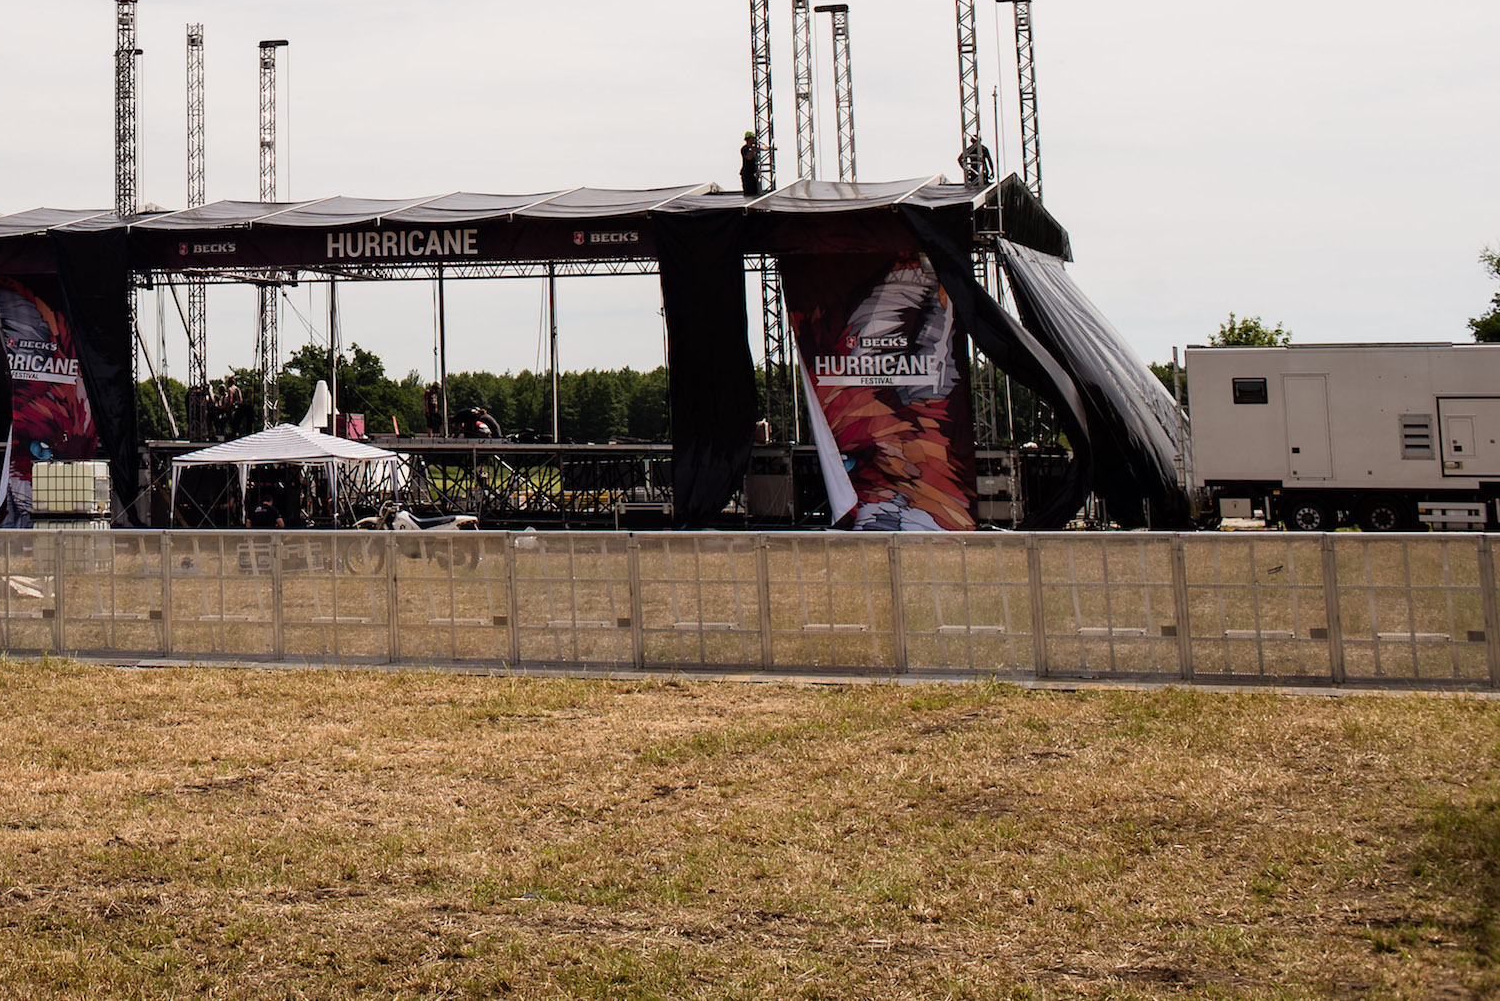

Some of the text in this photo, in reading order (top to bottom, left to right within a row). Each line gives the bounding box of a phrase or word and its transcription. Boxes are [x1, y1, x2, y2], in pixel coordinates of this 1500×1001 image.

[327, 228, 479, 258] HURRICANE
[590, 231, 639, 244] BECK'S
[193, 242, 237, 254] BECK'S
[18, 339, 58, 352] BECK'S
[861, 337, 909, 348] BECK'S
[814, 354, 940, 376] HURRICANE
[860, 377, 895, 385] FESTIVAL
